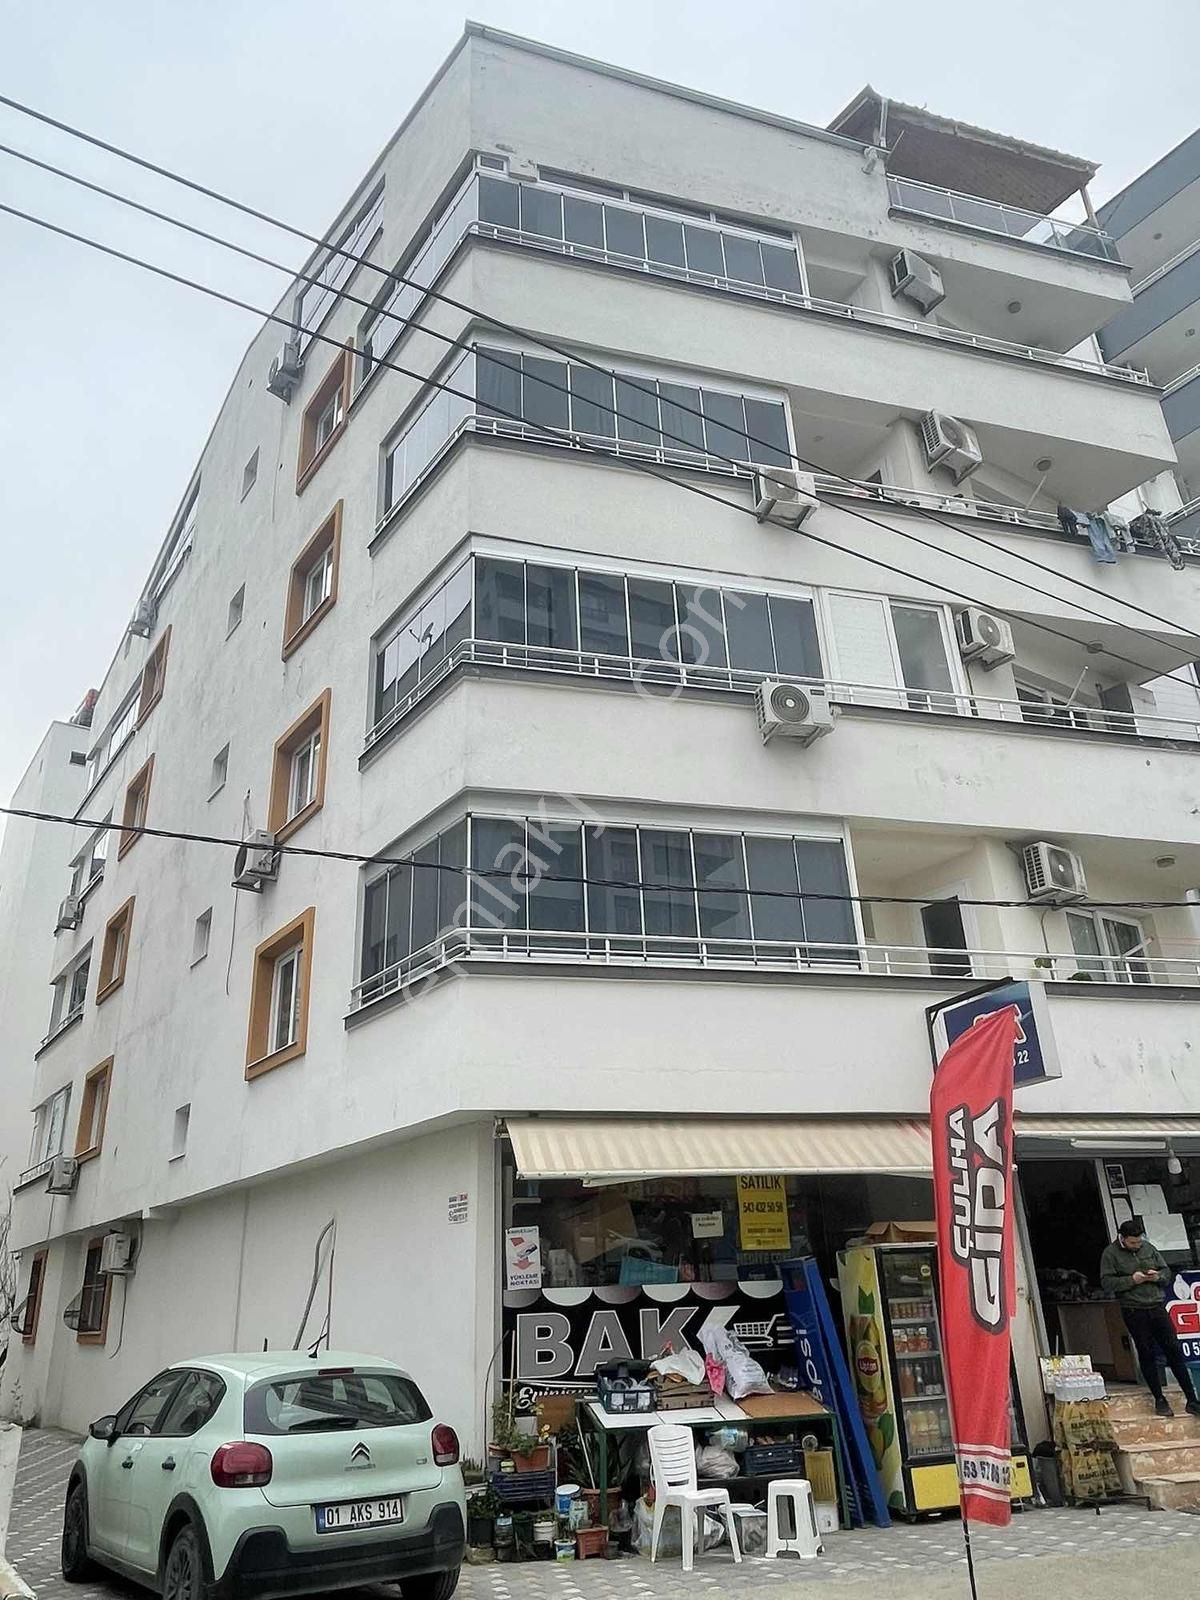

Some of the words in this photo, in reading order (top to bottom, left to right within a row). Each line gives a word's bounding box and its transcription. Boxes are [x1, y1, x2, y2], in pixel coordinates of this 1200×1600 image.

[741, 1175, 782, 1190] SATILIK
[796, 1329, 823, 1402] epsi
[326, 1507, 341, 1526] 01
[349, 1503, 373, 1523] AKS
[378, 1500, 399, 1519] 914
